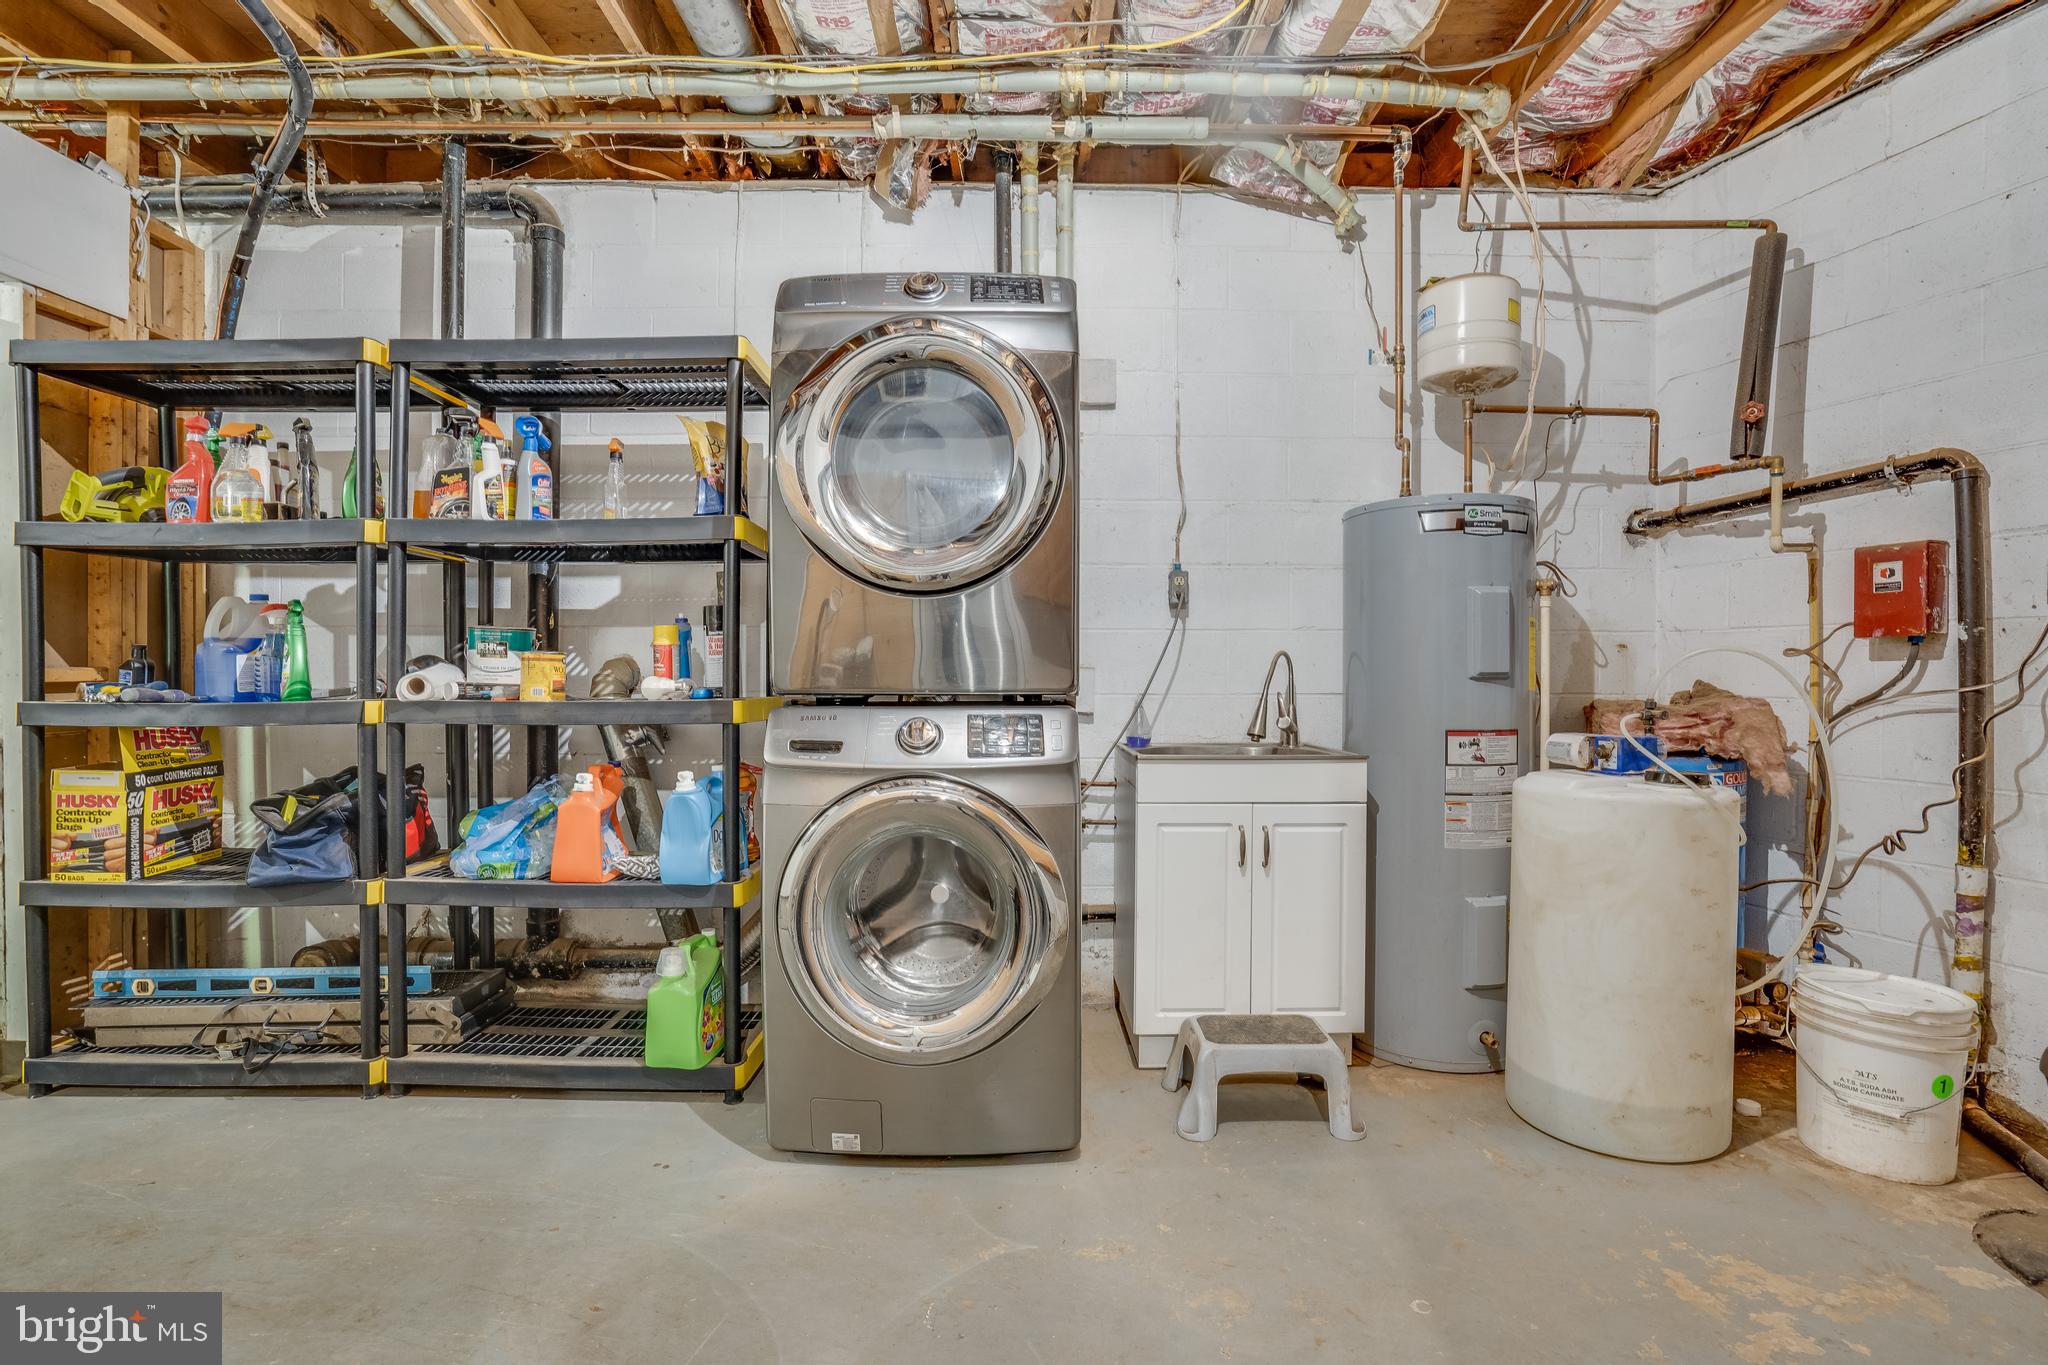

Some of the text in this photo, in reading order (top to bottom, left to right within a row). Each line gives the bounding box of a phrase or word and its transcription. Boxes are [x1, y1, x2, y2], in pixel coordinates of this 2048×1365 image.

[1480, 508, 1501, 518] Smith
[133, 726, 204, 752] HUSKY
[136, 751, 172, 761] Contractor
[134, 774, 146, 787] 50
[164, 767, 202, 781] CONTRACTOR
[203, 765, 218, 776] PACK
[56, 793, 120, 808] HUSKY
[127, 790, 144, 809] 50
[152, 781, 216, 811] HUSKY
[56, 808, 112, 816] Contractor
[151, 807, 184, 818] Contractor
[181, 812, 196, 821] Bags
[56, 816, 102, 824] Clean-Up
[56, 823, 82, 831] Bags
[130, 817, 141, 880] CONTRACTOR PACK
[146, 866, 155, 875] 50
[54, 873, 67, 881] 50
[1832, 1080, 1905, 1102] SODIUM CARBONATE
[1859, 1081, 1880, 1091] SODA
[1882, 1087, 1897, 1095] ASH
[1940, 1079, 1947, 1094] 1
